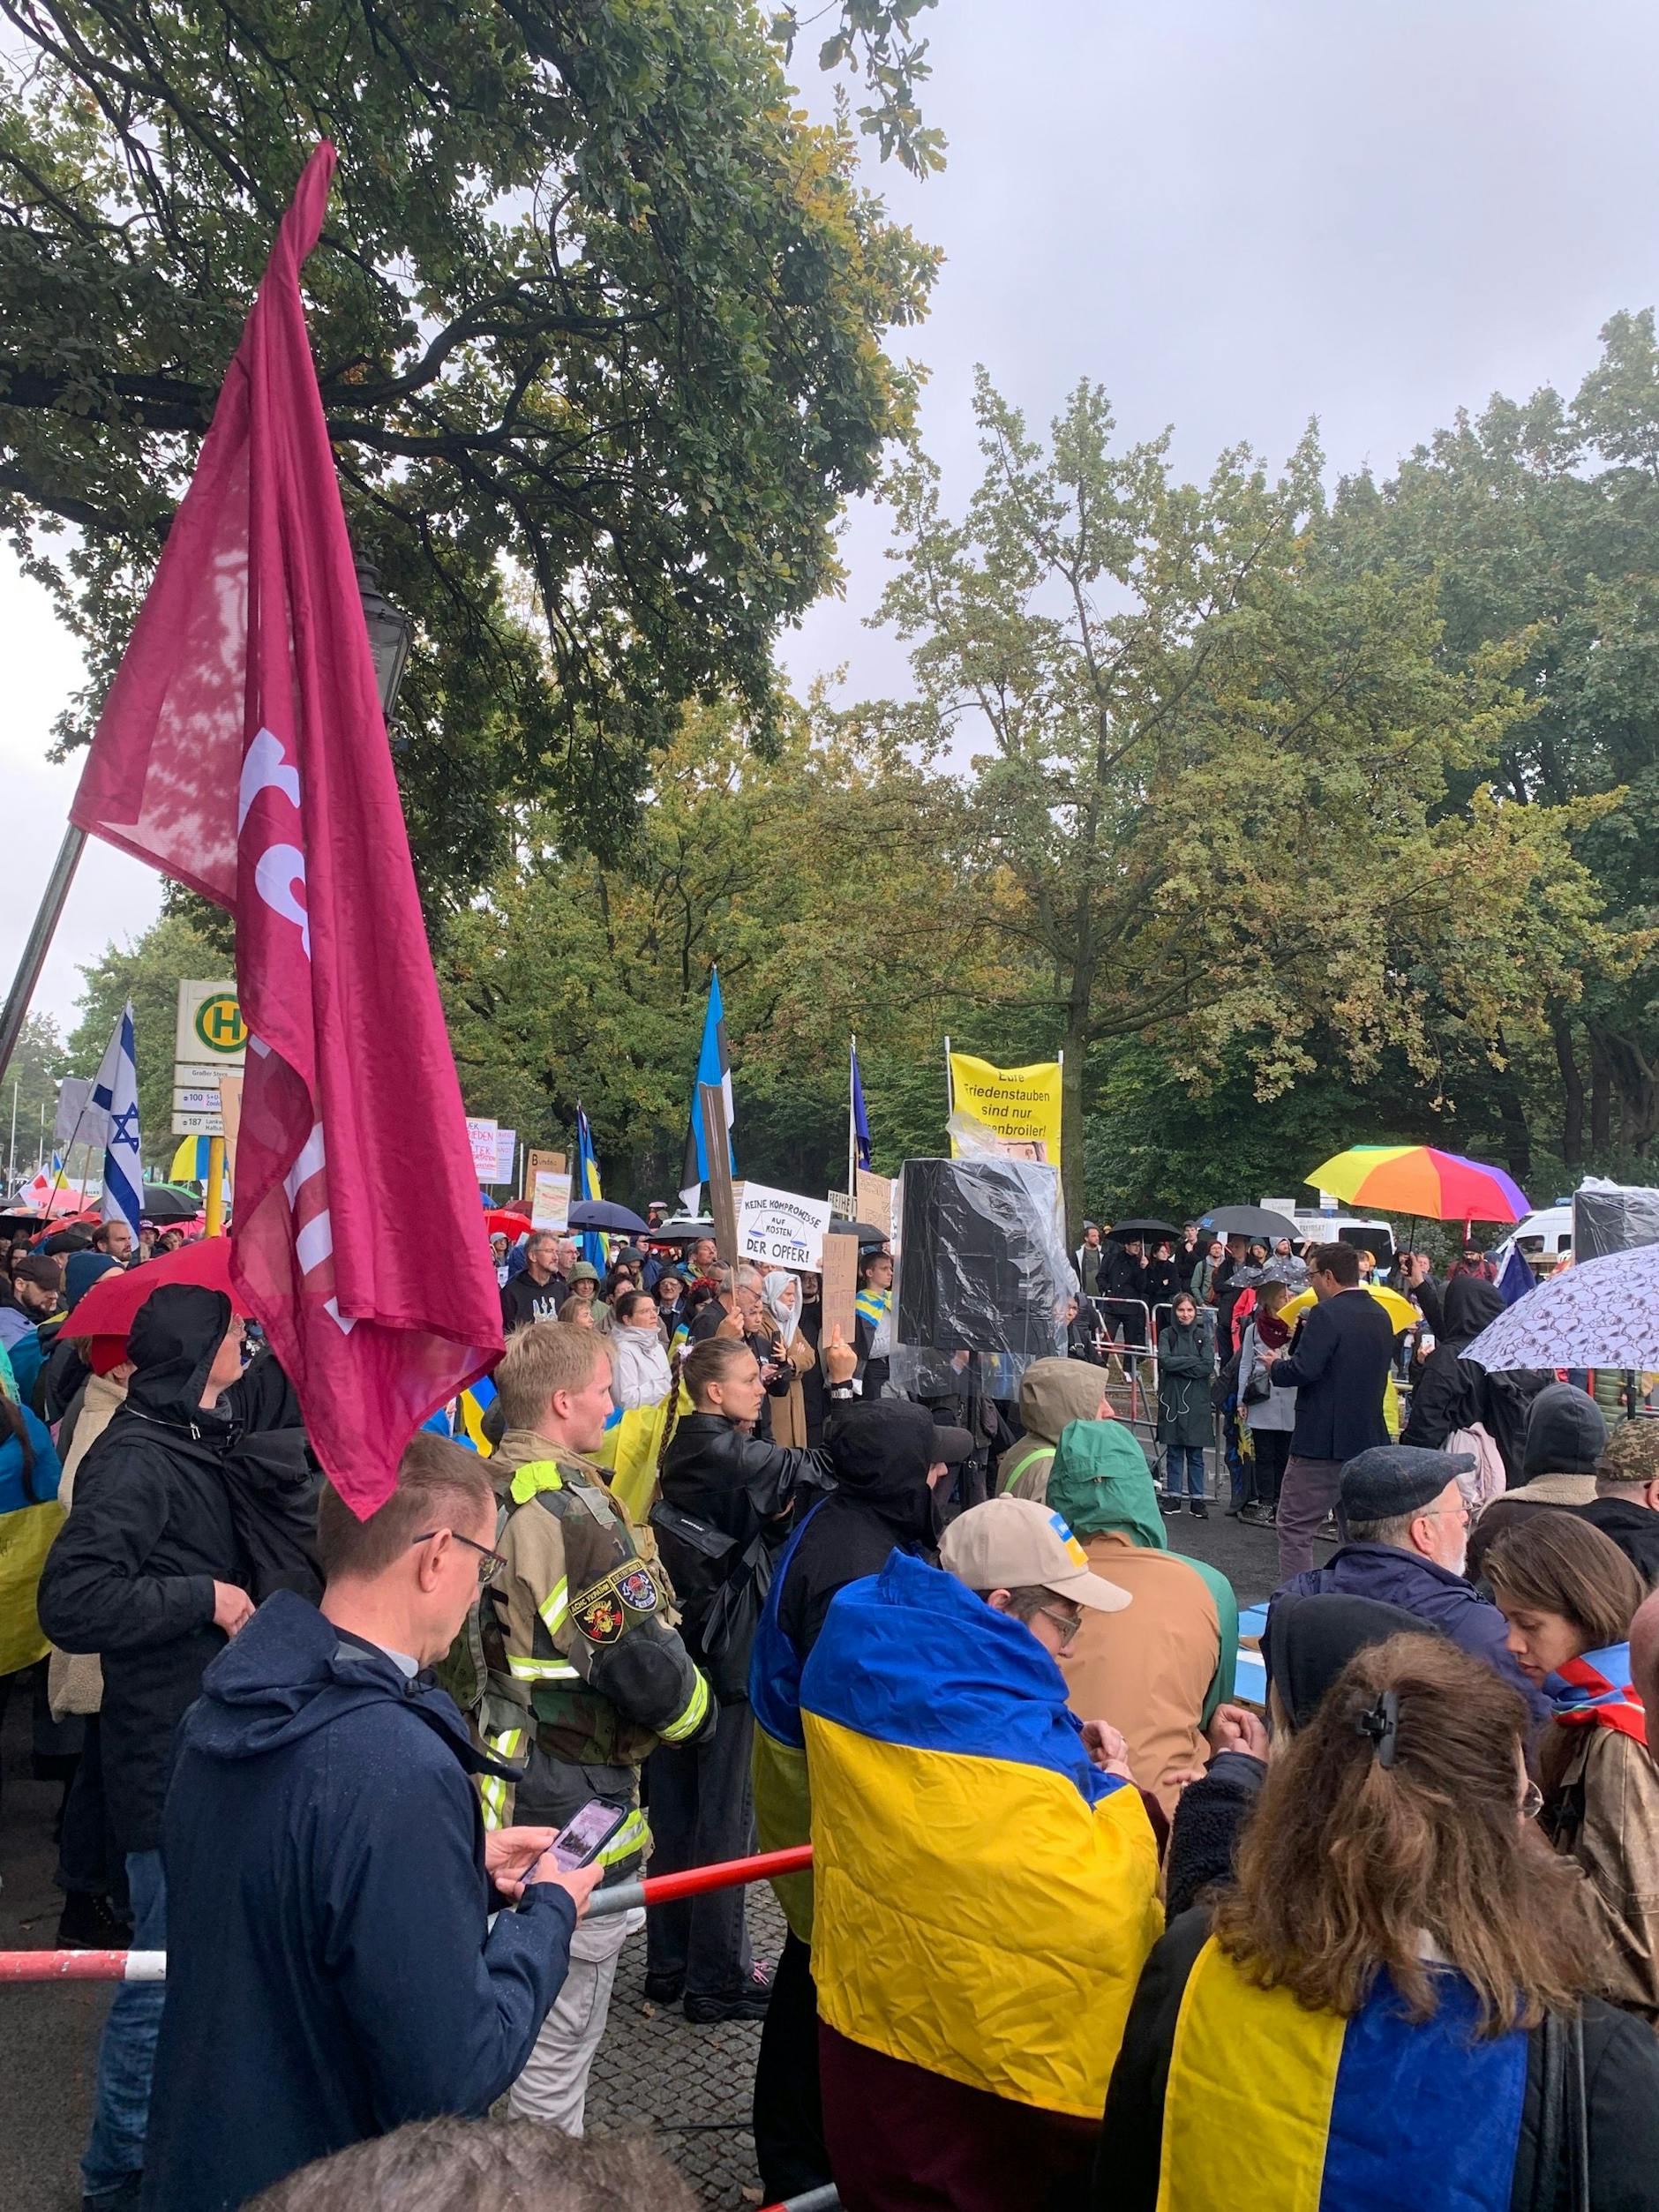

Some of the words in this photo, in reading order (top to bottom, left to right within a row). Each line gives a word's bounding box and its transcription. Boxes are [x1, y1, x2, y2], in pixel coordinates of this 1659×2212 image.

[213, 1007, 241, 1039] H
[981, 1104, 1009, 1117] sind
[1012, 1109, 1032, 1119] nur
[467, 1130, 494, 1142] RIEDEN
[745, 1199, 768, 1211] KEINE
[769, 1199, 822, 1229] KOMPROMISSE
[771, 1217, 786, 1226] AUF
[765, 1225, 792, 1237] KOSTEN
[747, 1238, 767, 1255] DER
[772, 1243, 810, 1263] OPFER!
